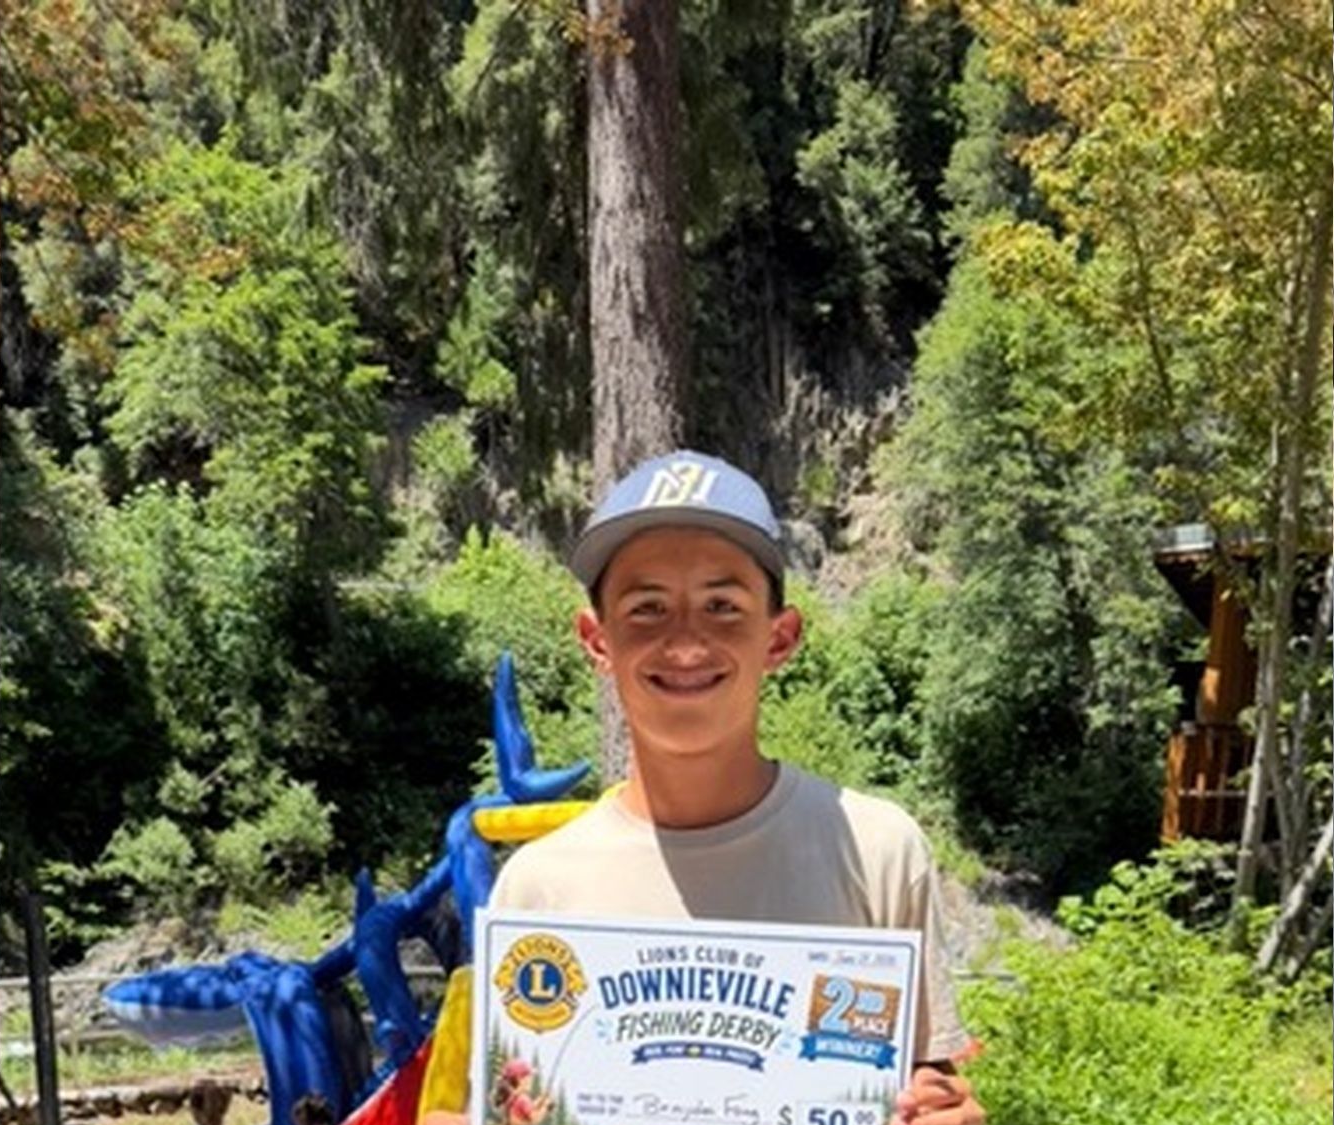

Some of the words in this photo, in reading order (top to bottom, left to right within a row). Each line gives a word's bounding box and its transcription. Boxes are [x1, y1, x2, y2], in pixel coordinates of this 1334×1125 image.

[637, 946, 689, 965] LIONS
[695, 946, 739, 964] CLUB
[743, 951, 765, 968] OF
[529, 963, 556, 996] L
[598, 966, 796, 1020] DOWNIEVILLE
[616, 1010, 705, 1042] FISHING
[706, 1011, 782, 1051] DERBY
